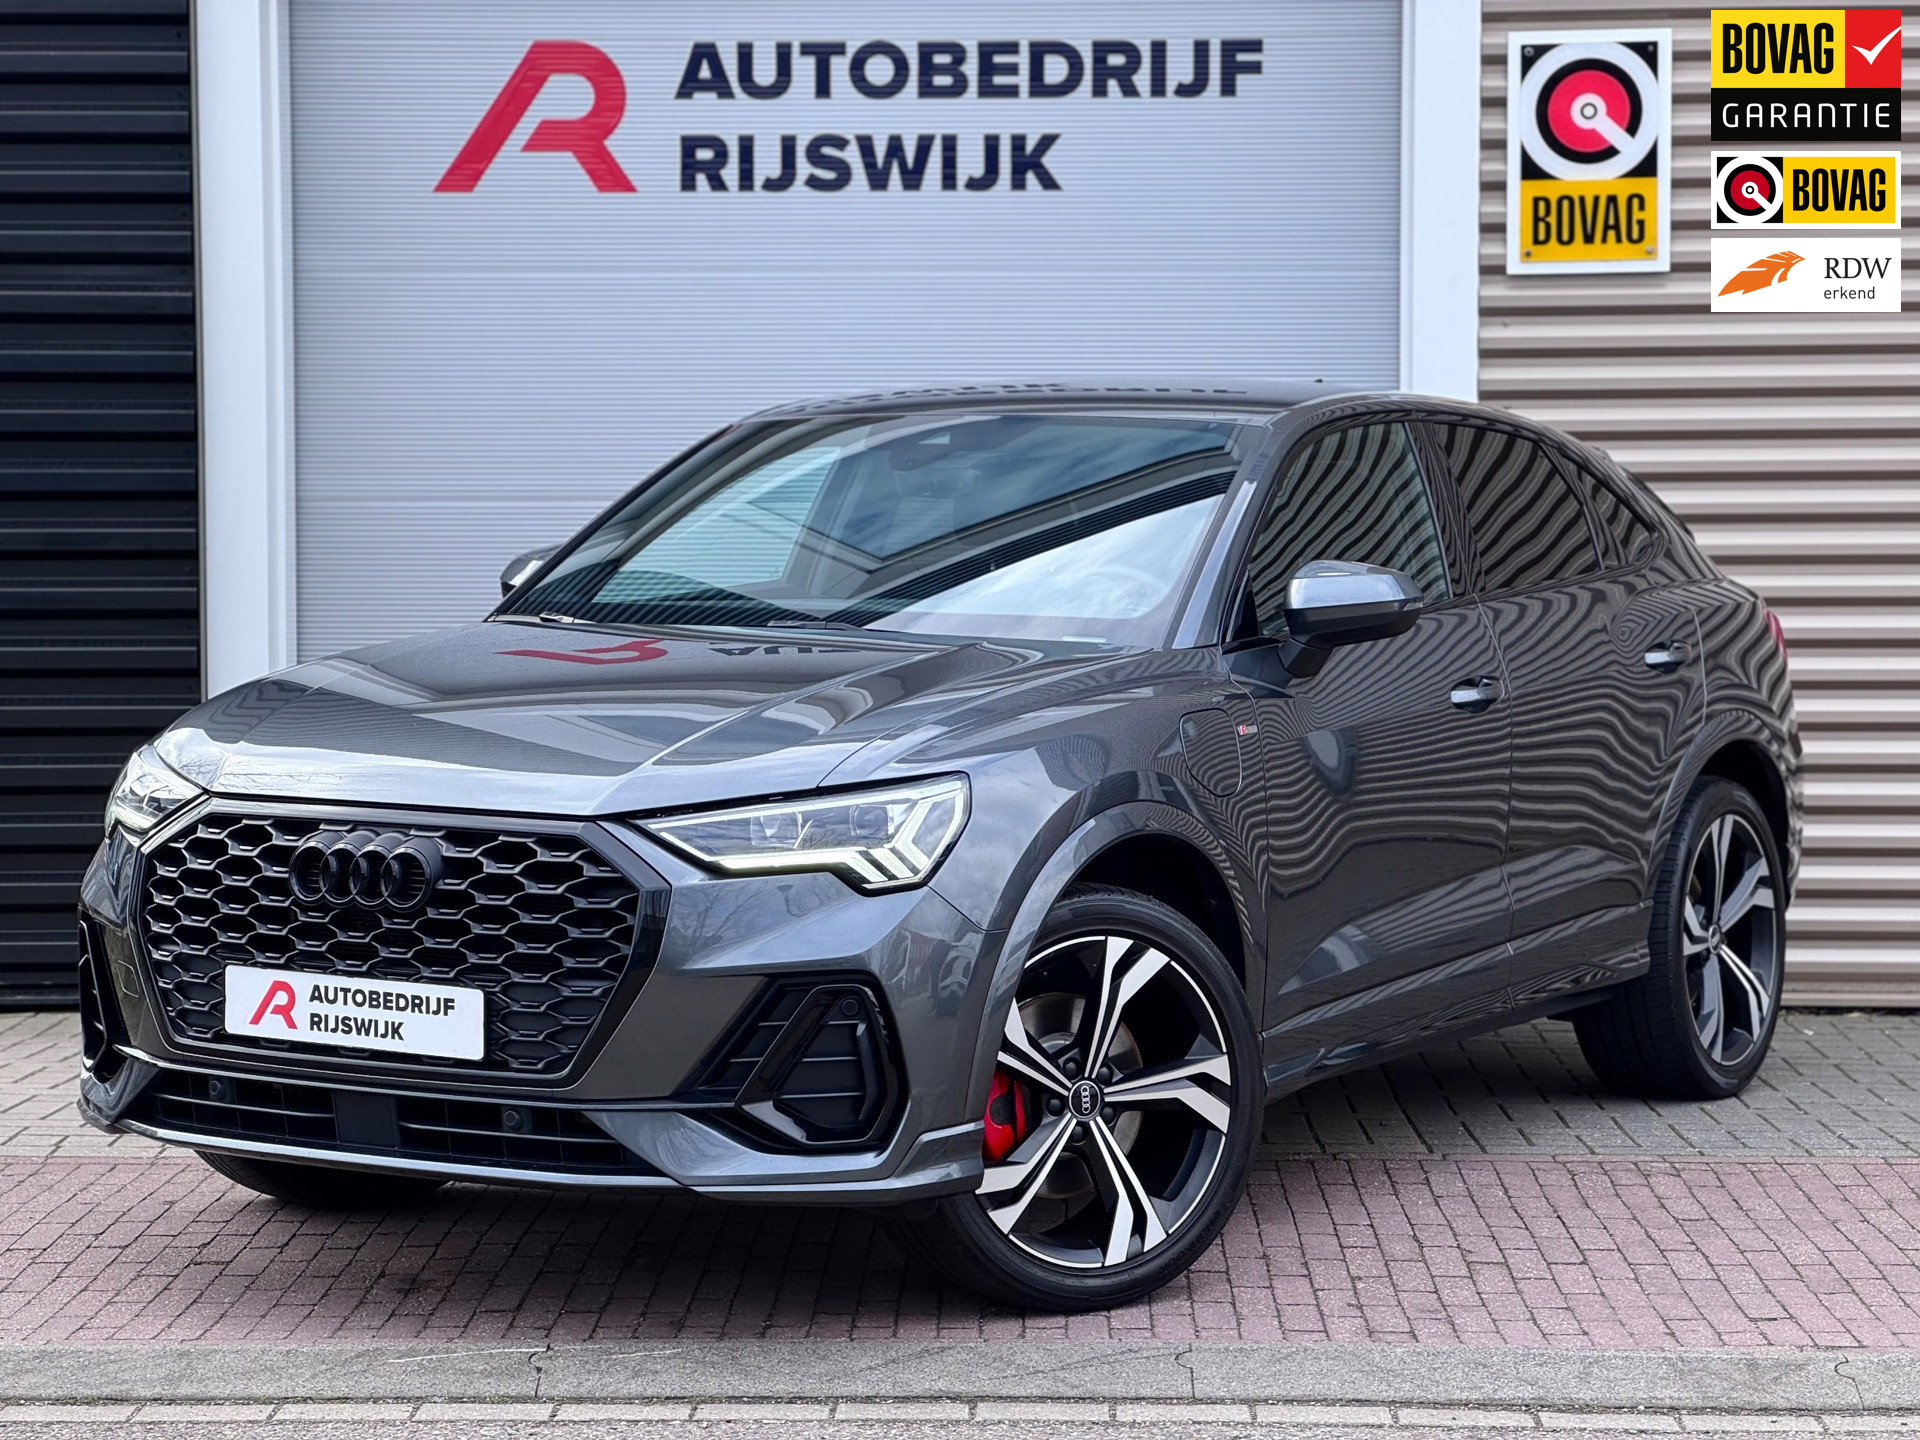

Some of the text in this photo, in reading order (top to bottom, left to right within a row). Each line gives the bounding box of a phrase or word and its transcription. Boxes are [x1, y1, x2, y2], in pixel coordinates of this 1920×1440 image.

[675, 39, 1263, 100] AUTOBEDRIJF
[679, 134, 1063, 192] RIJSWIJK
[1532, 193, 1646, 246] BOVAG
[308, 984, 456, 1017] AUTOBEDRIJF
[309, 1012, 404, 1041] RIJSWIJK
